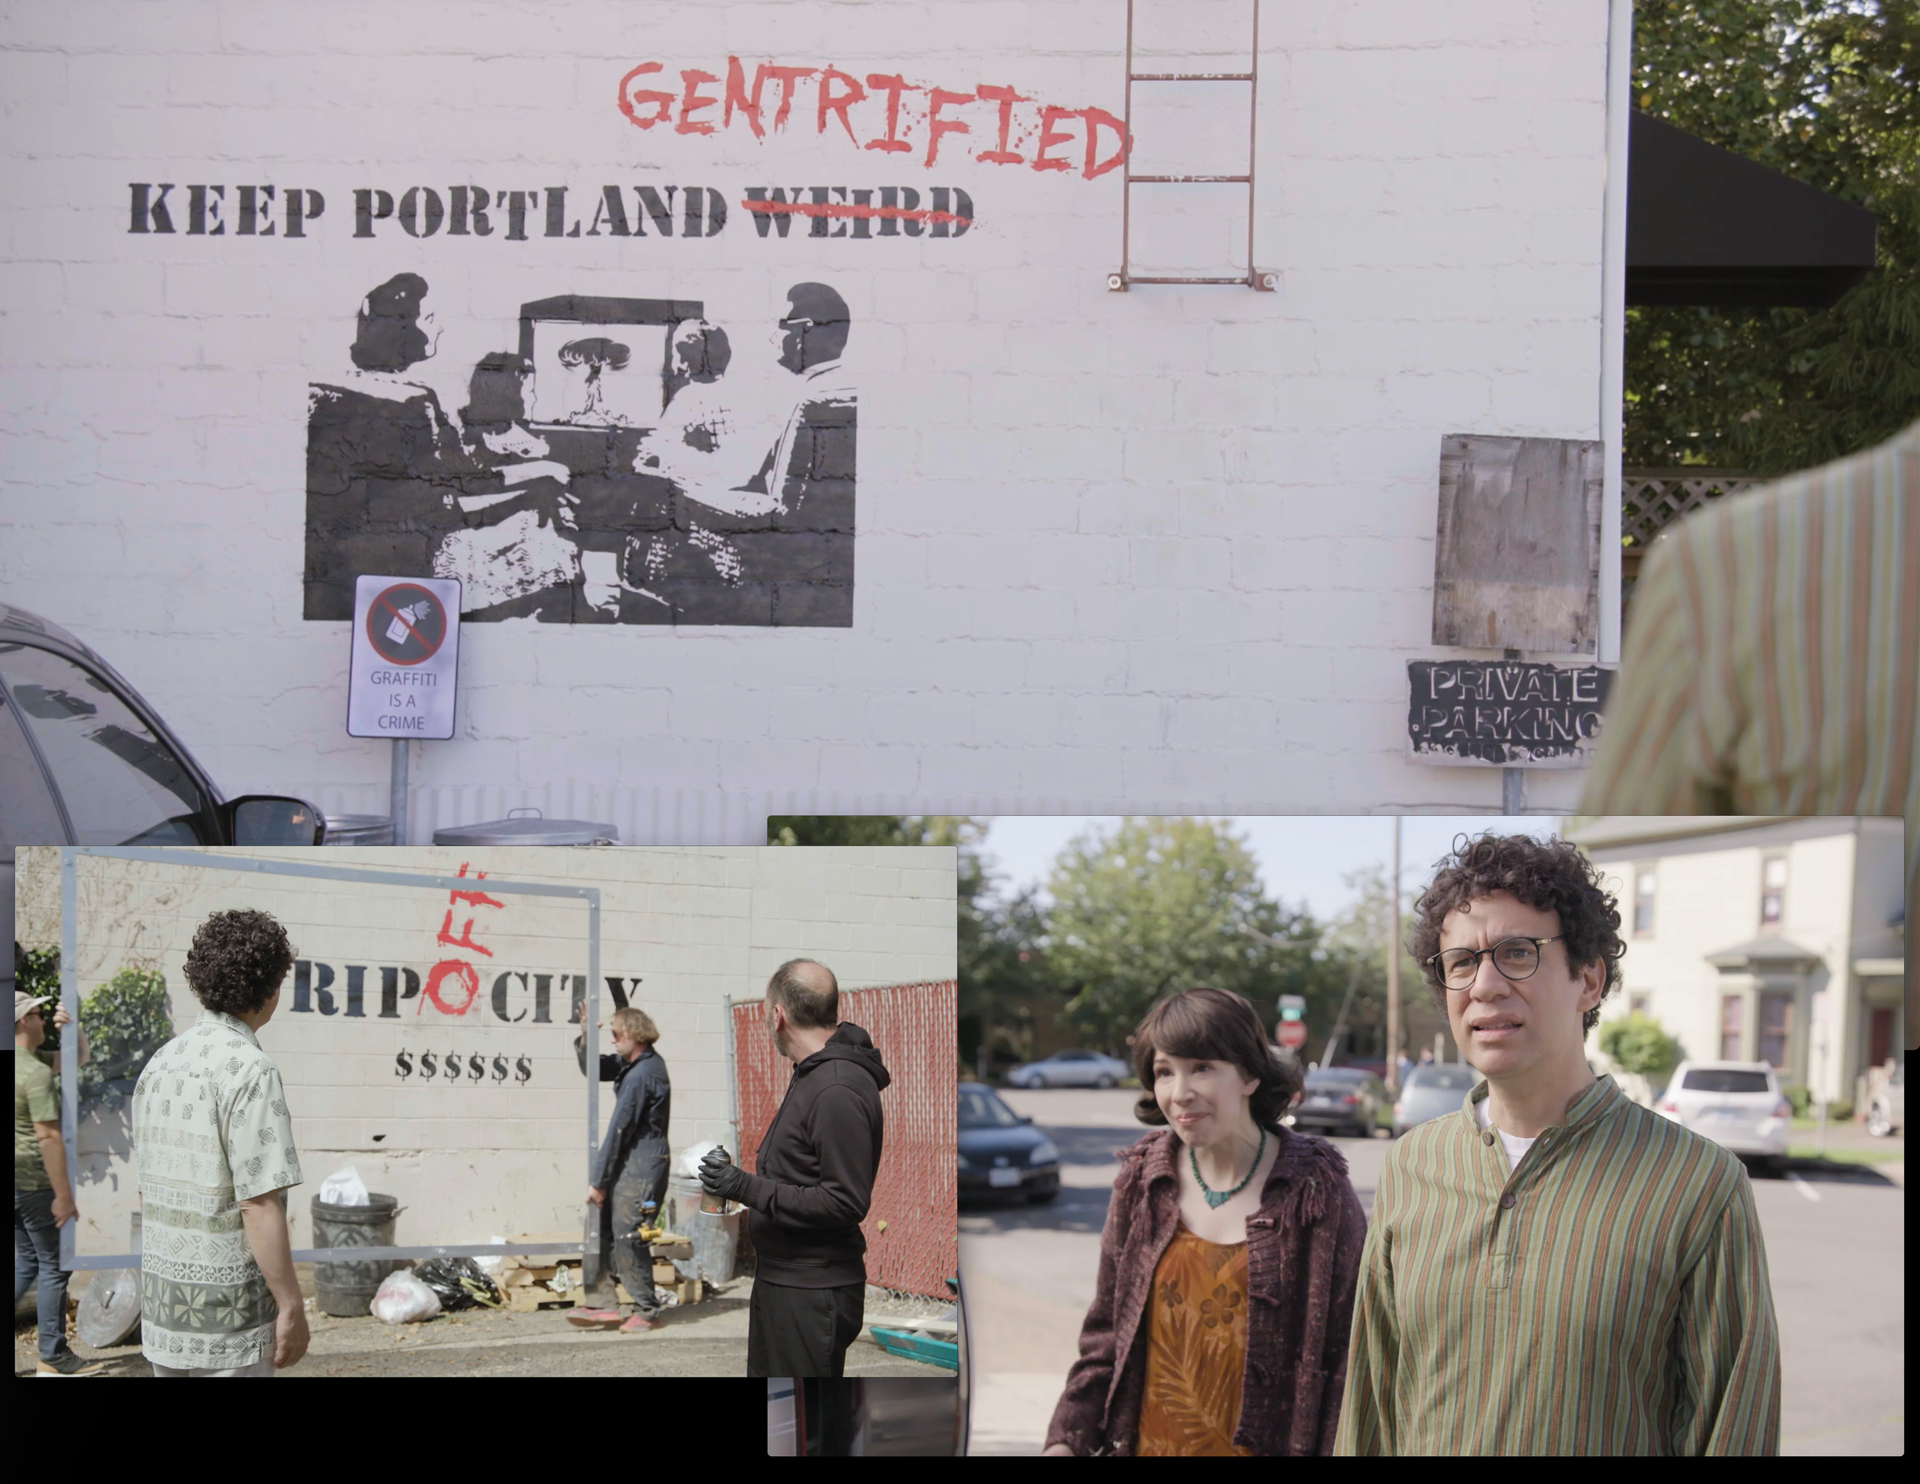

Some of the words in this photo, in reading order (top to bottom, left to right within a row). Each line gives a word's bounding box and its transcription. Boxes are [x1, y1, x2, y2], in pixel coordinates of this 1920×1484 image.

[617, 56, 1132, 181] GENTRIFIED
[128, 182, 324, 238] KEEP
[352, 183, 727, 241] PORTLAND
[743, 185, 974, 239] WEIRD
[371, 671, 437, 686] GRAFFITI
[1428, 667, 1598, 702] PRIVATE
[389, 694, 402, 707] IS
[405, 694, 416, 707] A
[378, 715, 425, 730] CRIME
[290, 959, 420, 1019] RIP
[491, 971, 643, 1024] CITY
